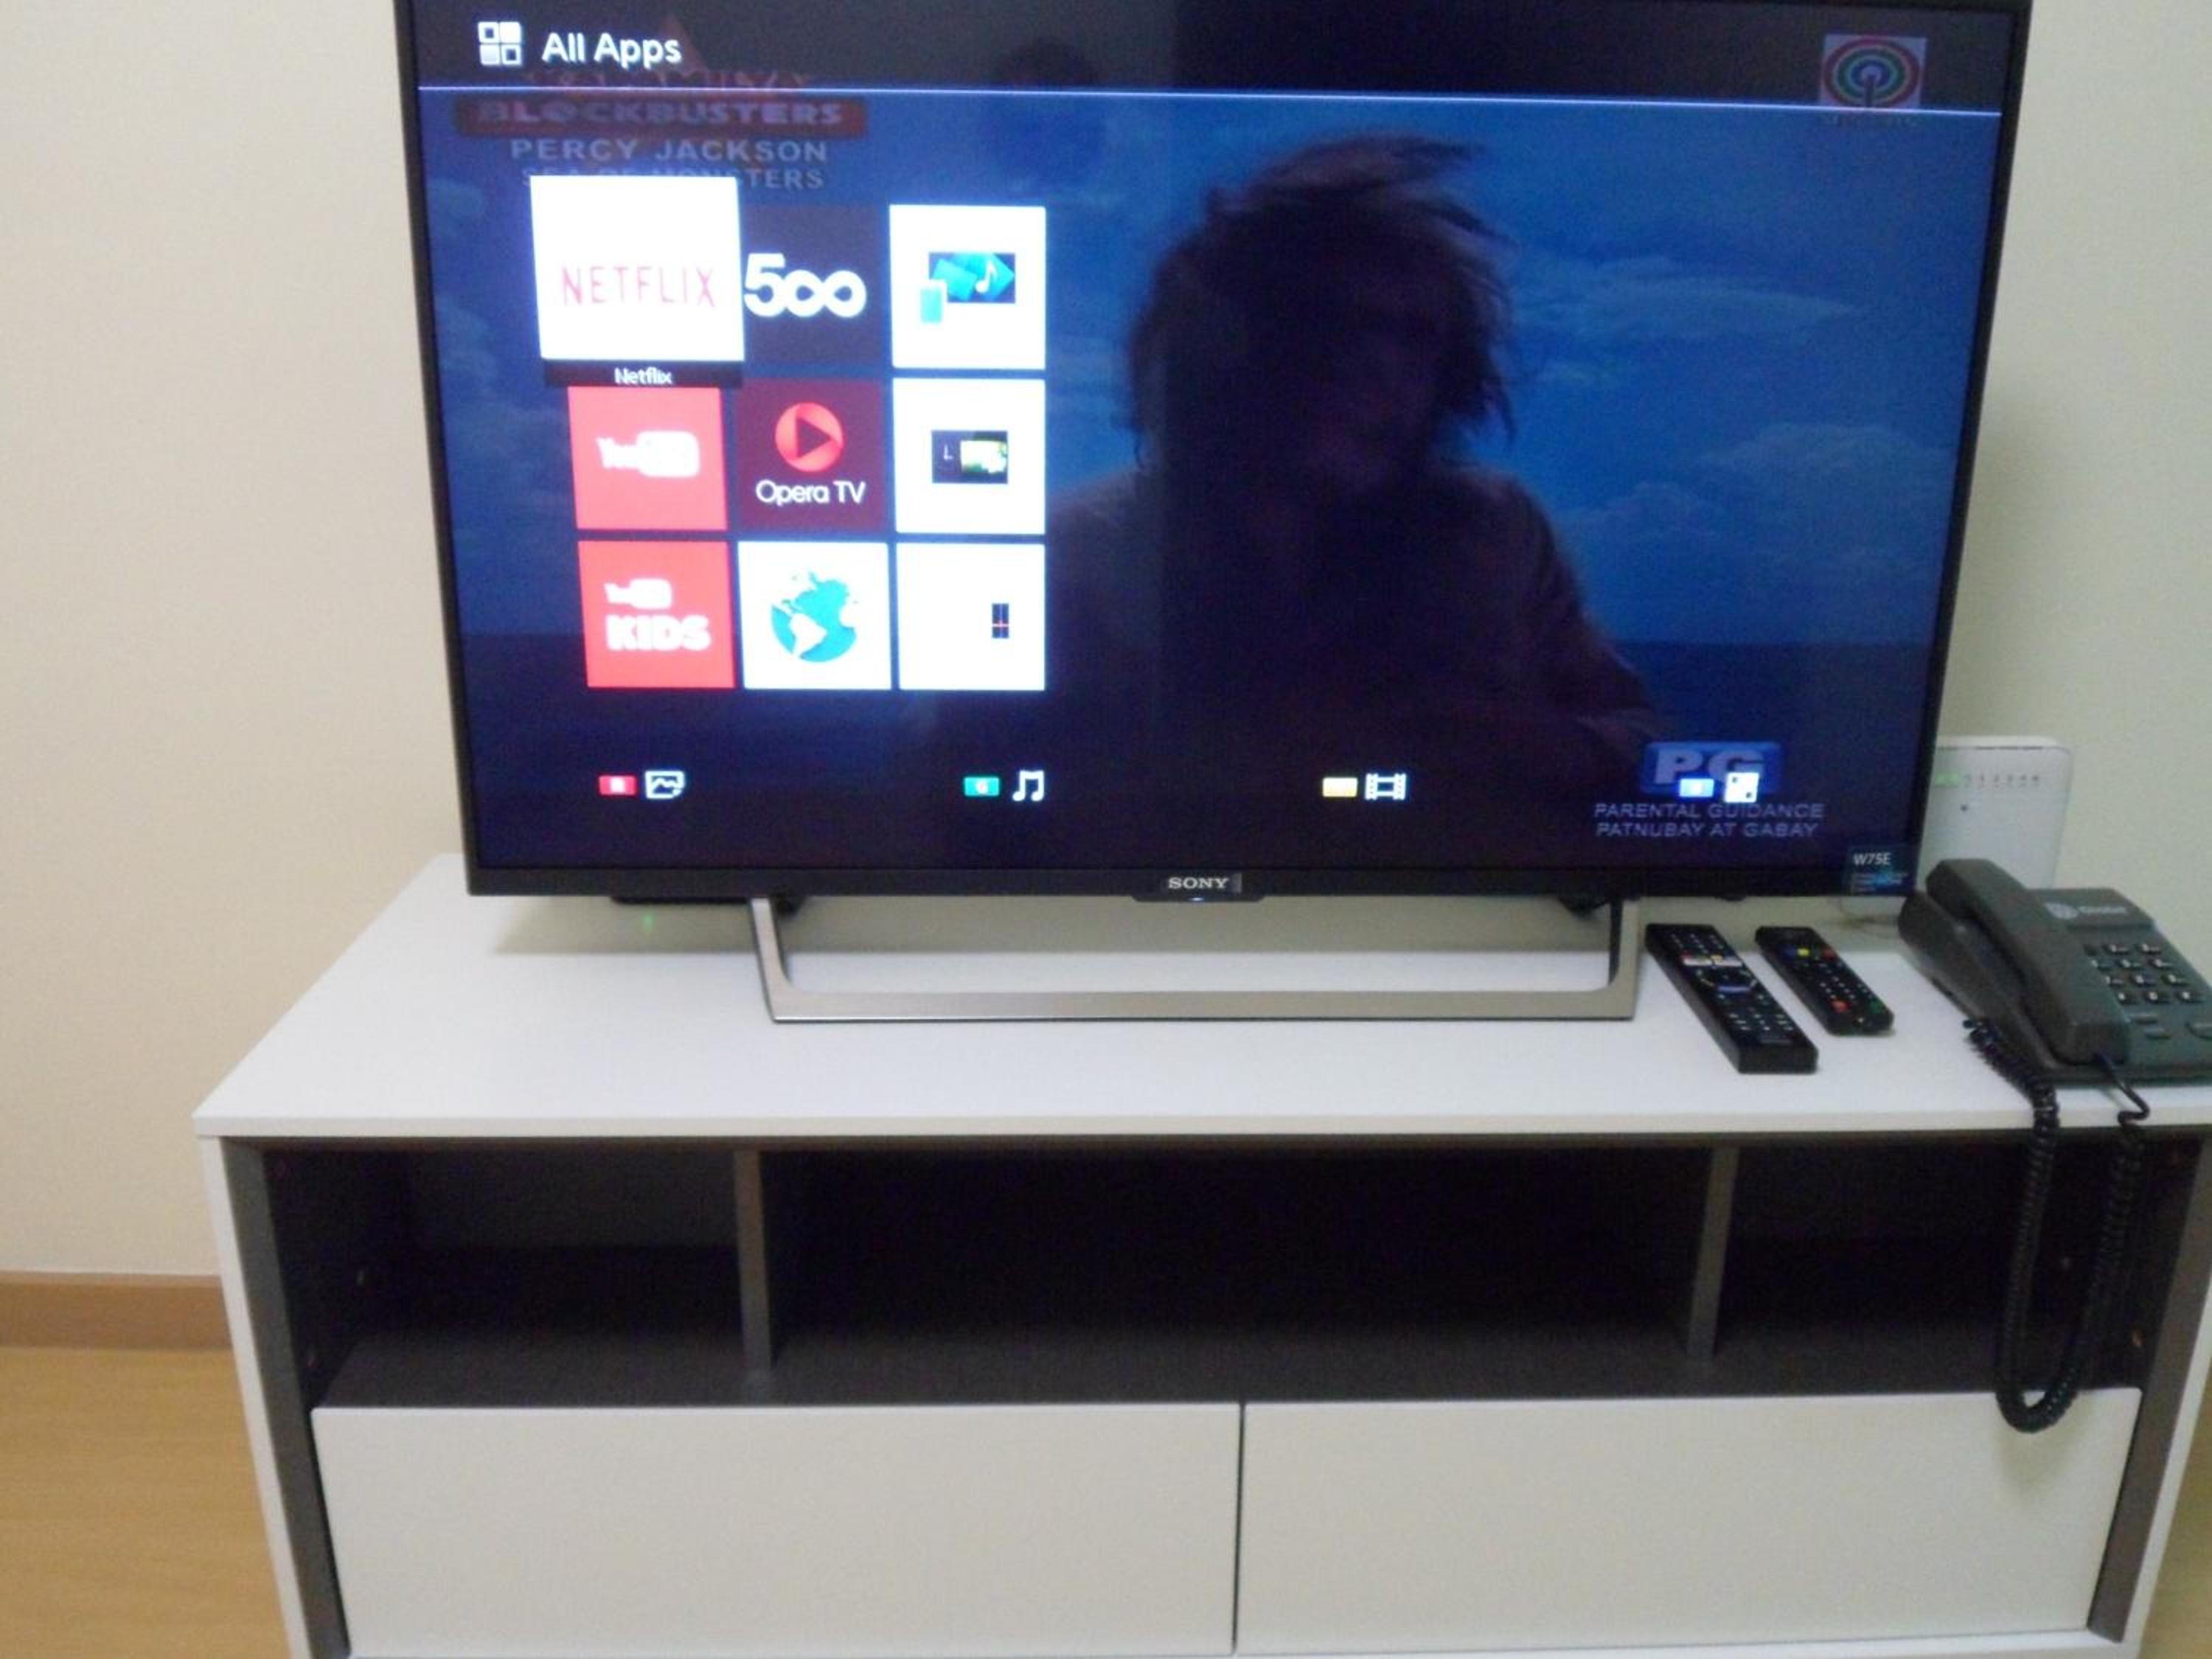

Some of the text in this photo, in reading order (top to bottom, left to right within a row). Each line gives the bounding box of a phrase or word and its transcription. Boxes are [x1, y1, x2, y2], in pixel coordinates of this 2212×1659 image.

[541, 32, 682, 70] All Apps
[478, 100, 843, 125] BLOCKBUSTERS
[509, 139, 827, 163] PERCY JACKSON
[562, 265, 716, 307] NETFLIX
[613, 366, 673, 386] Netflix
[755, 479, 866, 507] Opera TV
[605, 613, 712, 652] KIDS
[1593, 802, 1826, 818] PARENTAL GUIDANCE
[1596, 822, 1818, 838] PATNUBAY AT GABAY
[1168, 877, 1230, 889] SONY
